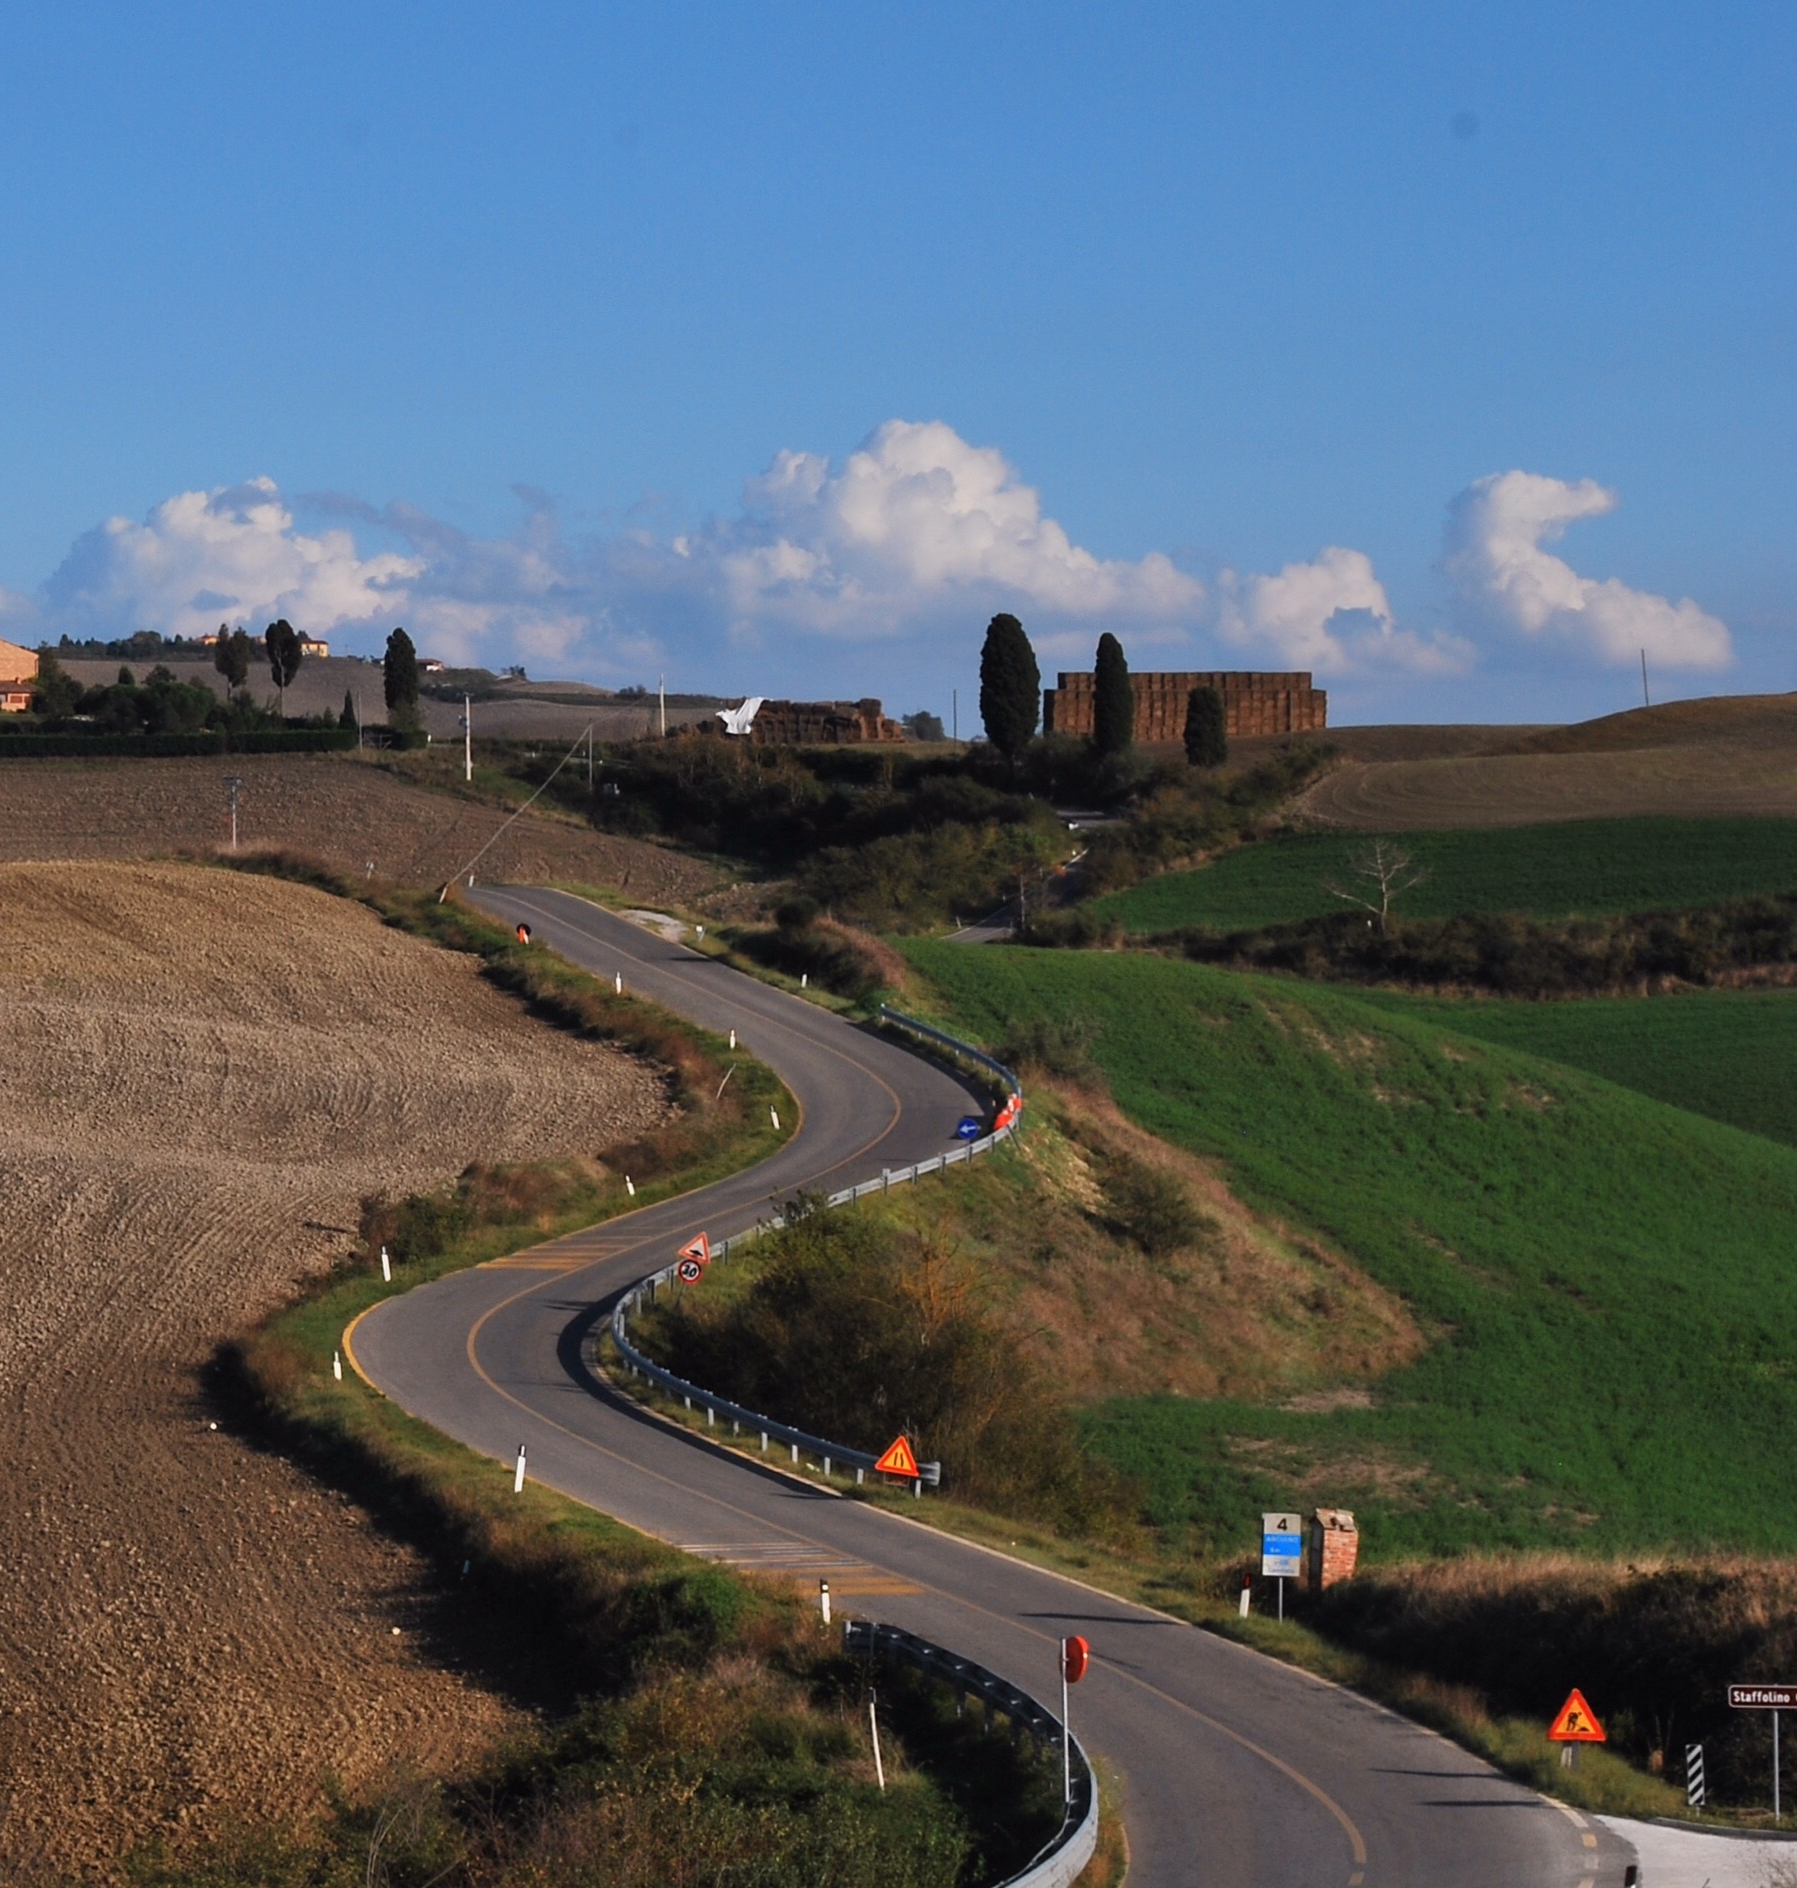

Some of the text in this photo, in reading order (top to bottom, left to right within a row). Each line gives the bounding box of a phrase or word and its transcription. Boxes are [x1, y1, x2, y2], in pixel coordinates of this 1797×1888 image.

[682, 1264, 697, 1278] 30
[1277, 1518, 1288, 1531] 4
[1733, 1690, 1791, 1703] Staffolino
